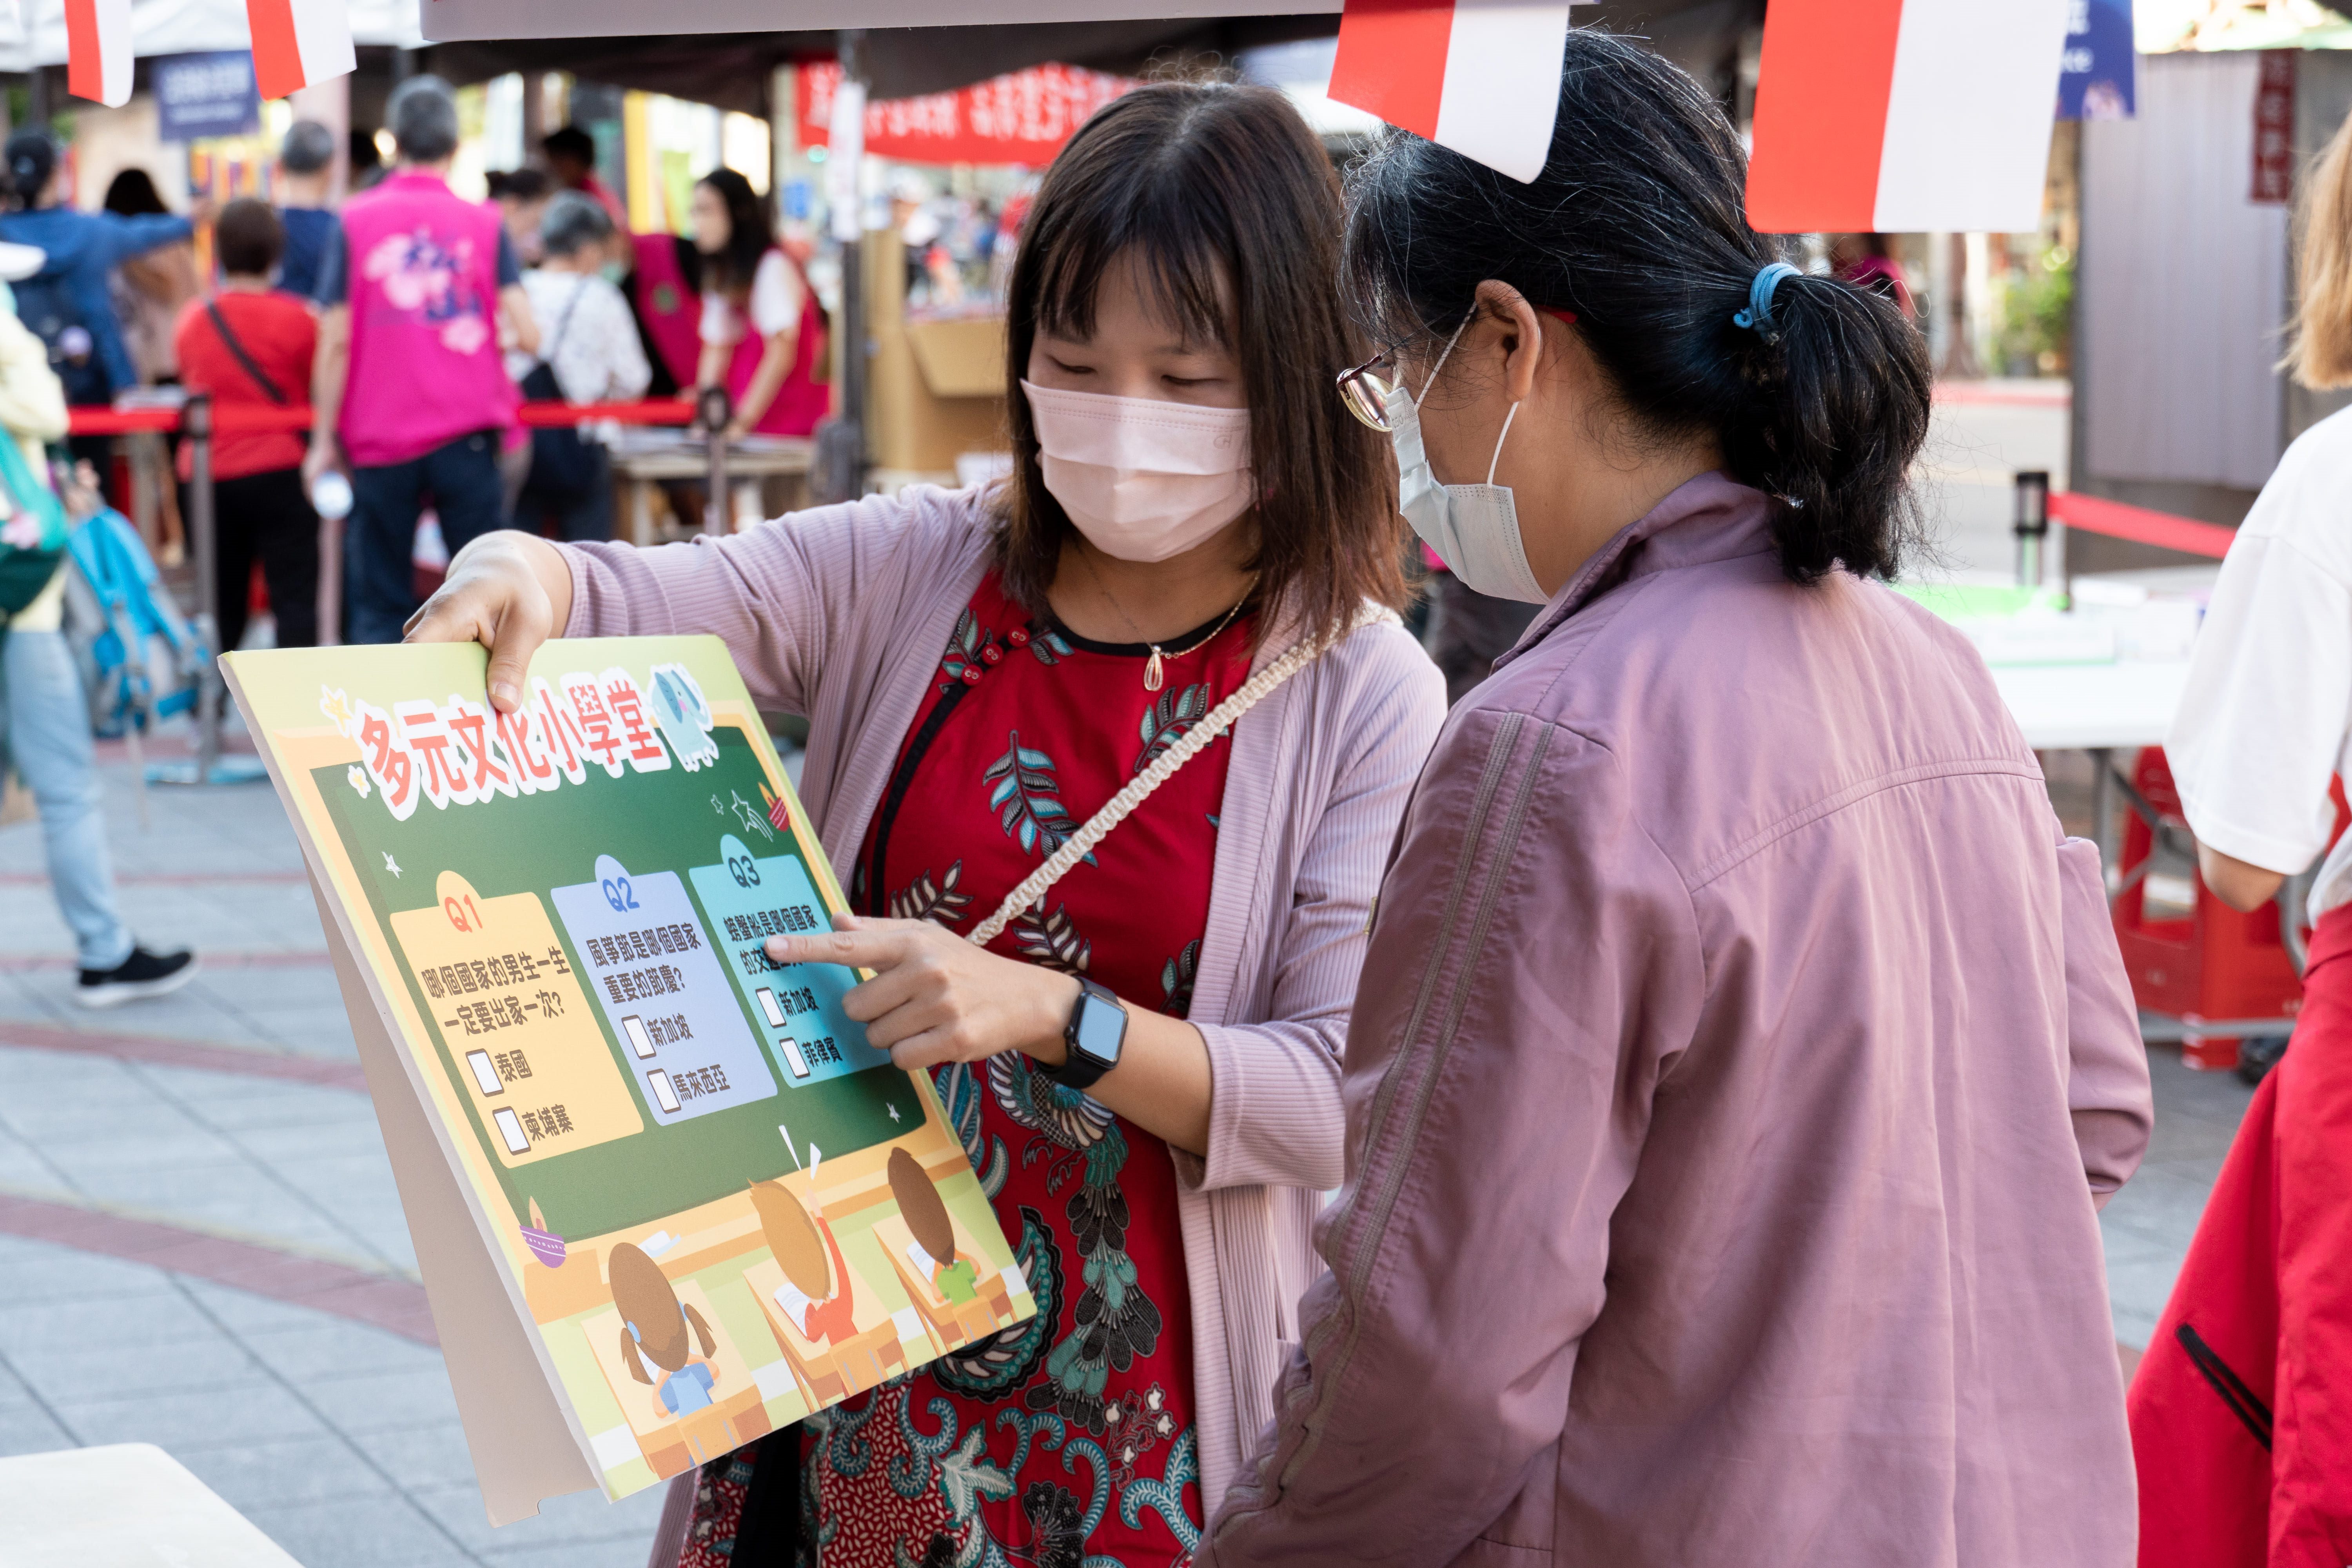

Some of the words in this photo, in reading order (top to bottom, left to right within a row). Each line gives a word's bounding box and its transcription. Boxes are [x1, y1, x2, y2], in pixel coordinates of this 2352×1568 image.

[360, 679, 663, 808] 多元文化小學堂
[728, 855, 760, 888] Q3
[444, 894, 483, 933] Q1
[603, 877, 640, 913] Q2
[723, 904, 818, 942] 螃蟹船是哪個國家
[586, 922, 701, 968] 風箏節是哪個國家
[421, 946, 570, 999] 哪個國家的男生一生
[603, 964, 685, 1004] 重要的節慶?
[445, 989, 565, 1036] 一定要出家一次?
[779, 986, 819, 1016] 新加坡
[647, 1013, 694, 1047] 新加坡
[495, 1049, 533, 1082] 泰國
[802, 1037, 843, 1067] 菲律賓
[672, 1064, 731, 1102] 馬來西亞
[522, 1104, 574, 1142] 柬埔寨
